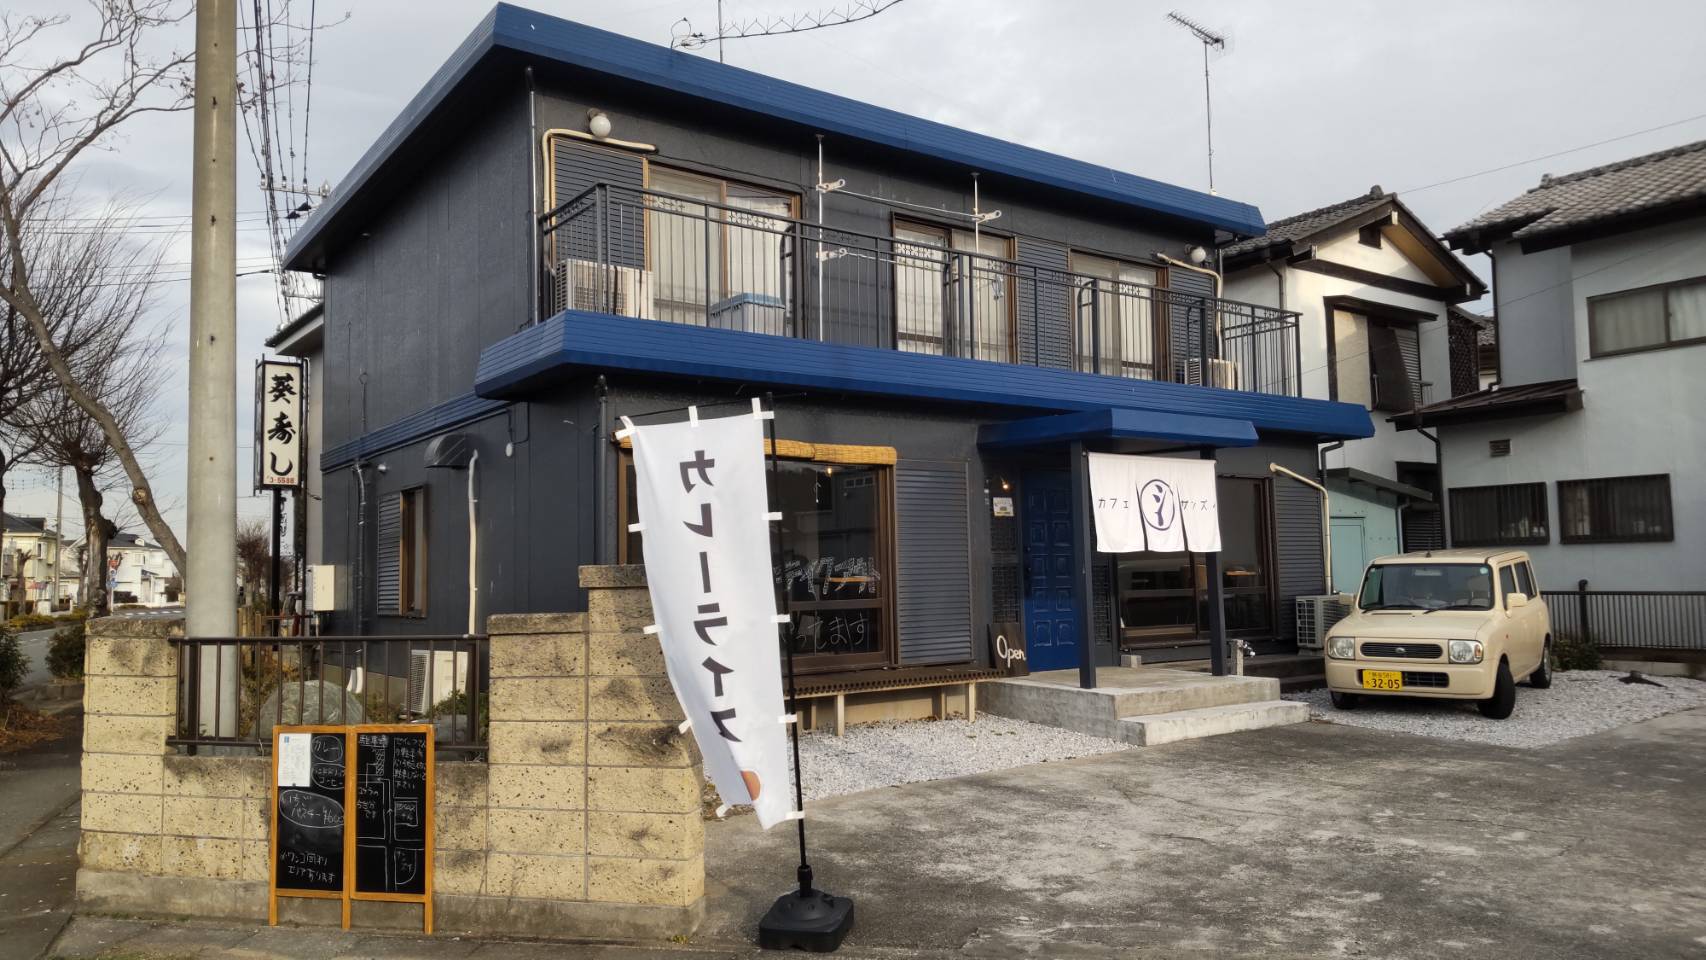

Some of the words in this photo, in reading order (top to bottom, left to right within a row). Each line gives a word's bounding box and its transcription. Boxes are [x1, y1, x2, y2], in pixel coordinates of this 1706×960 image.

[267, 372, 297, 476] 葵寿し
[1098, 498, 1129, 509] カフェ
[996, 635, 1027, 669] Open
